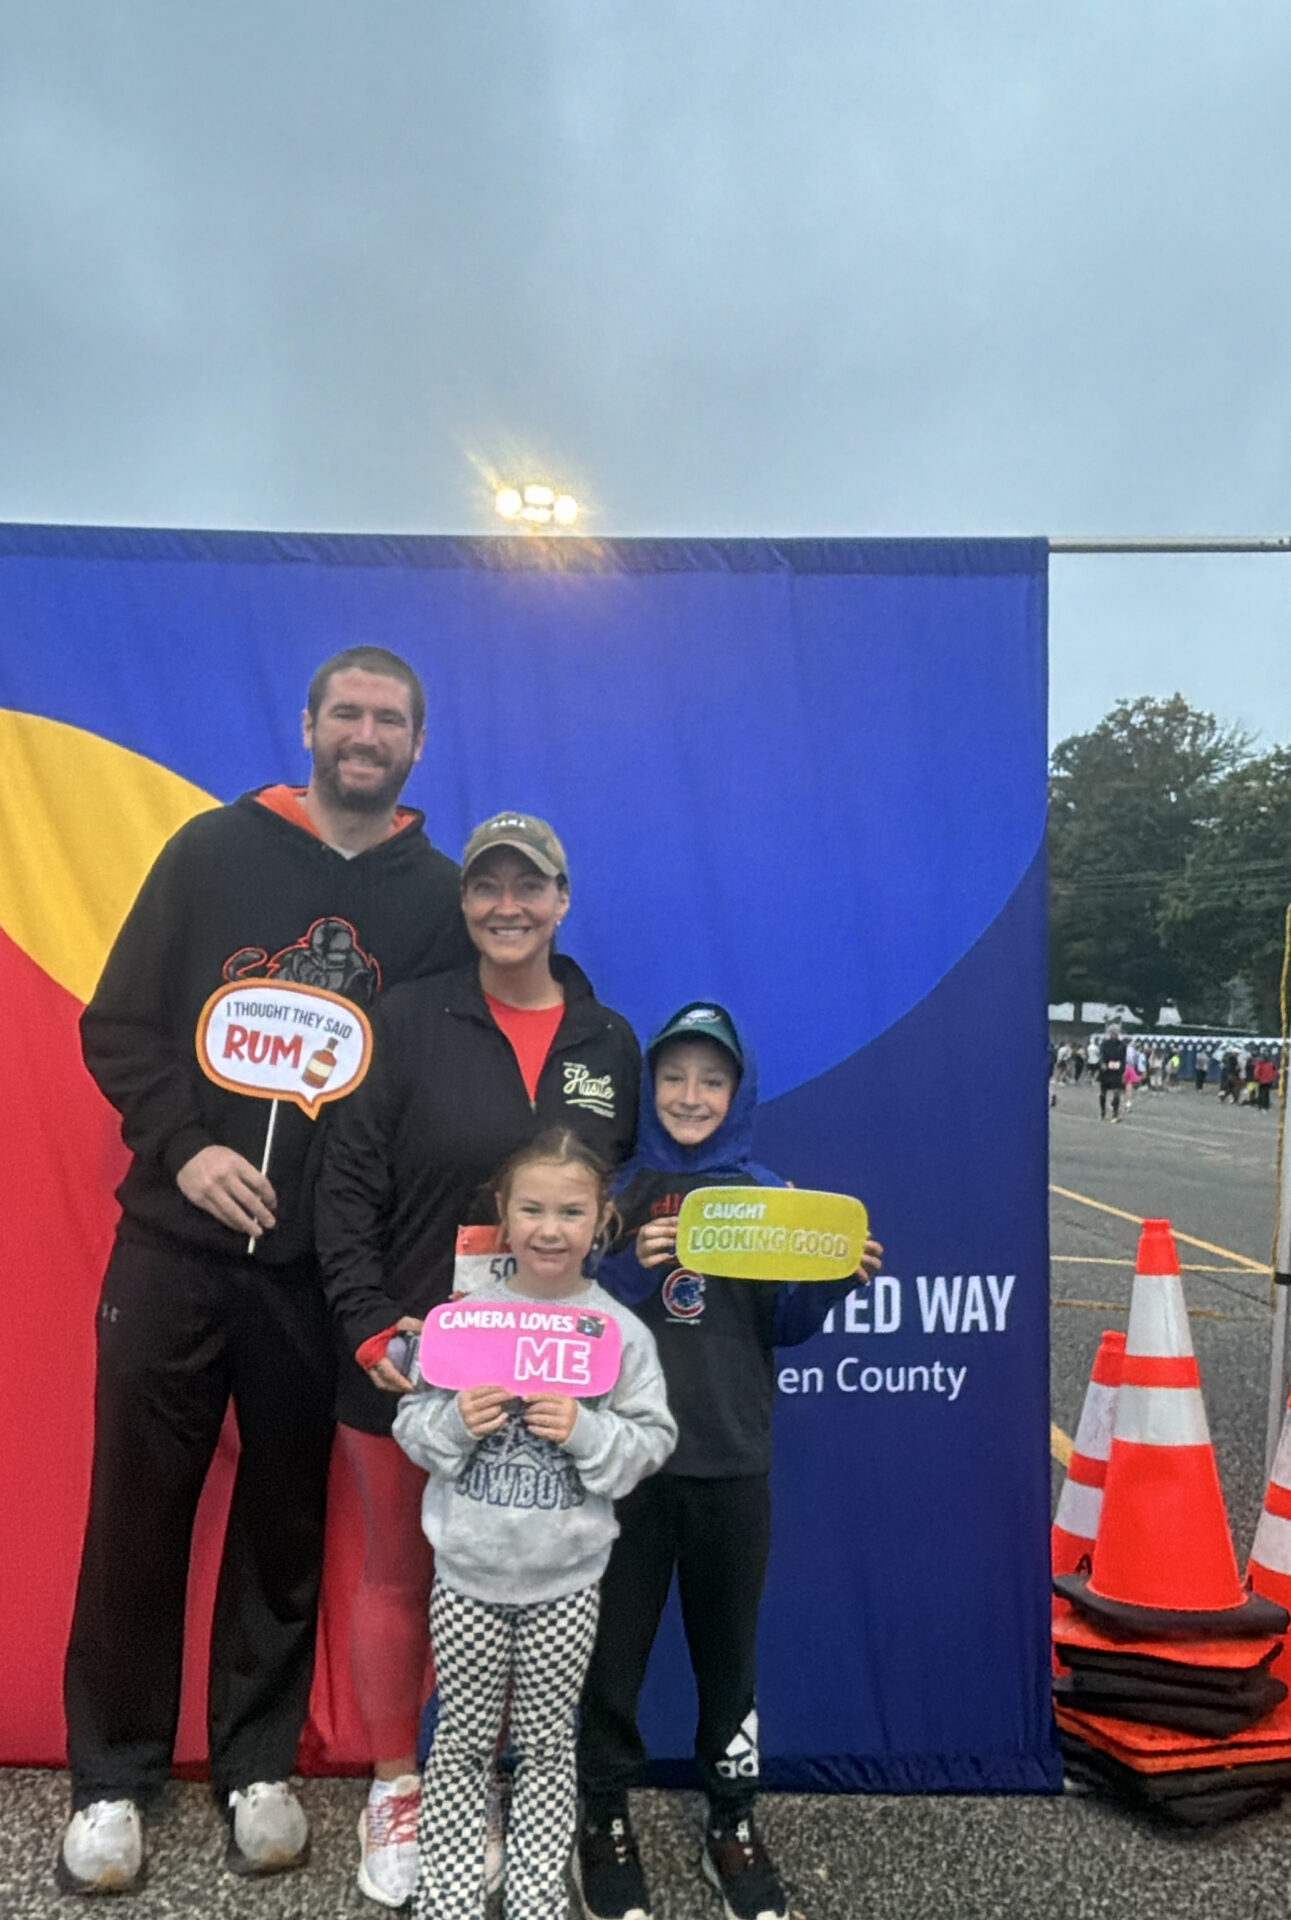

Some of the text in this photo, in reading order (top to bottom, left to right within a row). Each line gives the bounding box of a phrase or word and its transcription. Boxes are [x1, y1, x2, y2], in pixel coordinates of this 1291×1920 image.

[226, 1001, 352, 1039] I THOUGHT THEY SAID
[223, 1023, 303, 1069] RUM
[703, 1202, 766, 1219] CAUGHT
[688, 1226, 849, 1259] LOOKING GOOD
[439, 1310, 574, 1333] CAMERA LOVES
[916, 1275, 1016, 1333] WAY
[514, 1336, 591, 1385] ME
[777, 1357, 968, 1401] en County
